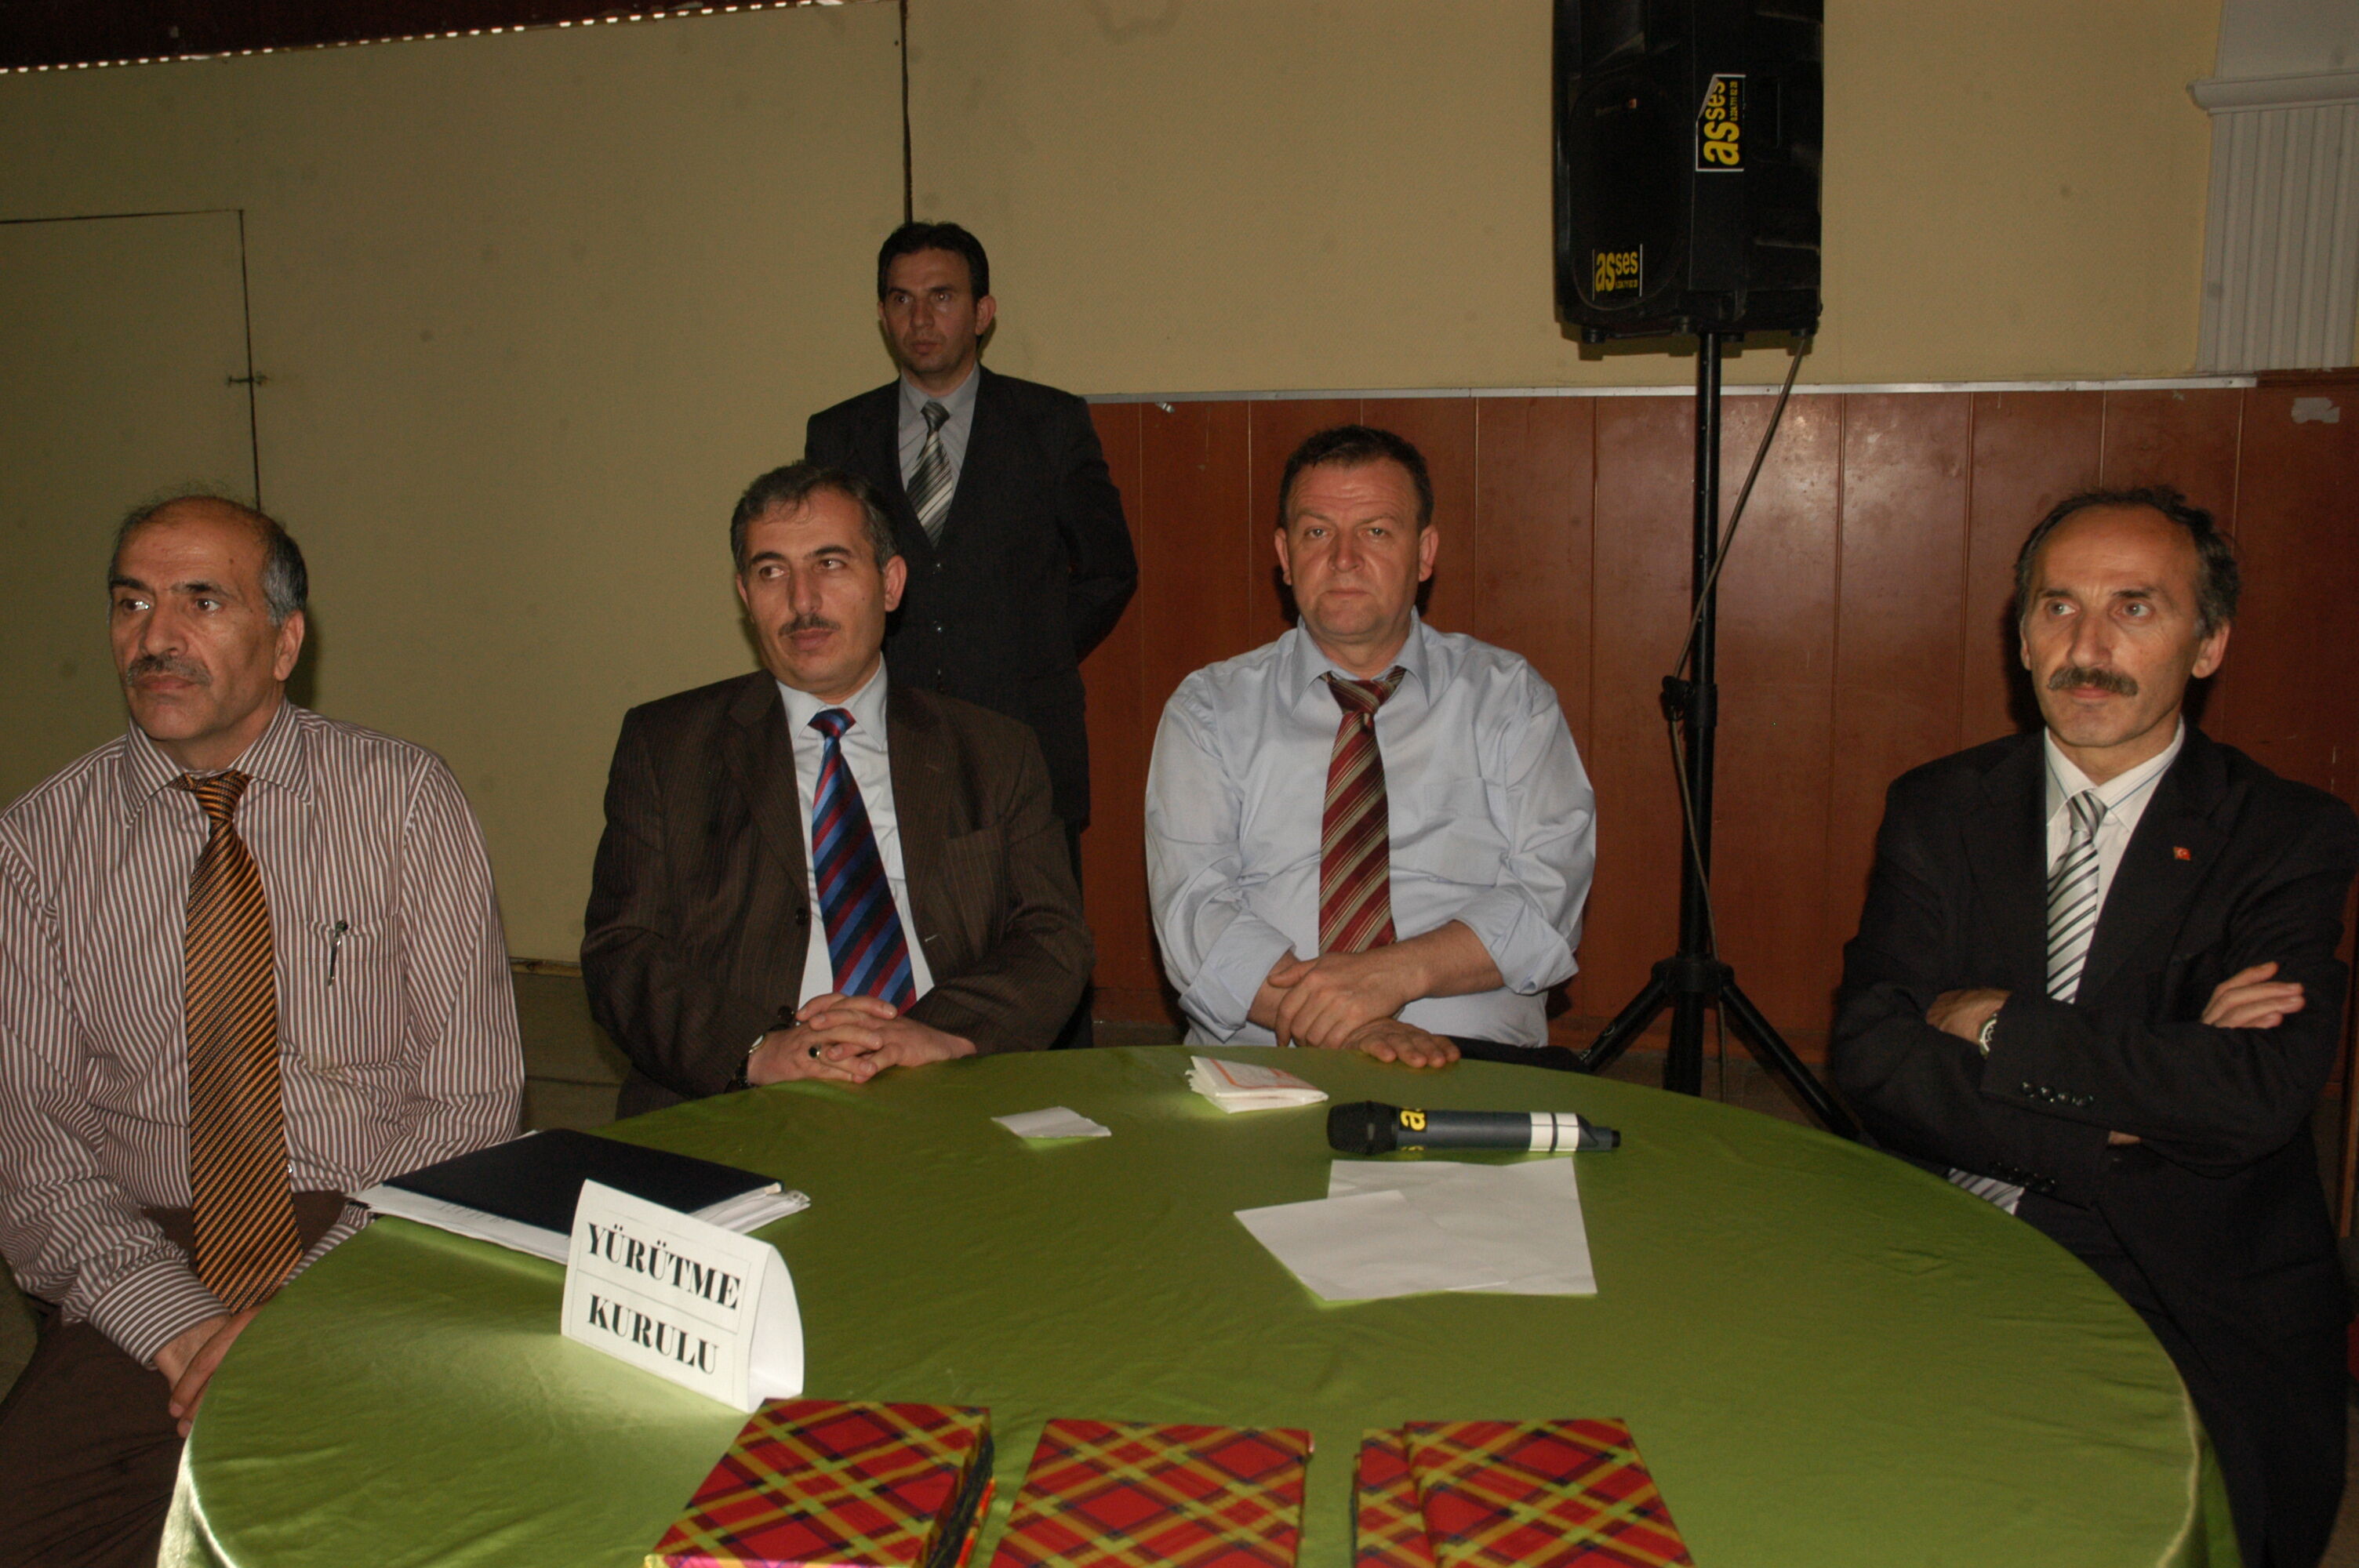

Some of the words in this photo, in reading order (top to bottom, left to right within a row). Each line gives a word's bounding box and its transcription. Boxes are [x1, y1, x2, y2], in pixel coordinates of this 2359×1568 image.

[1703, 81, 1739, 165] asses
[1595, 251, 1639, 292] asses
[1400, 1109, 1427, 1131] a
[587, 1222, 740, 1310] YÜRÜTME
[587, 1294, 718, 1374] KURULU
